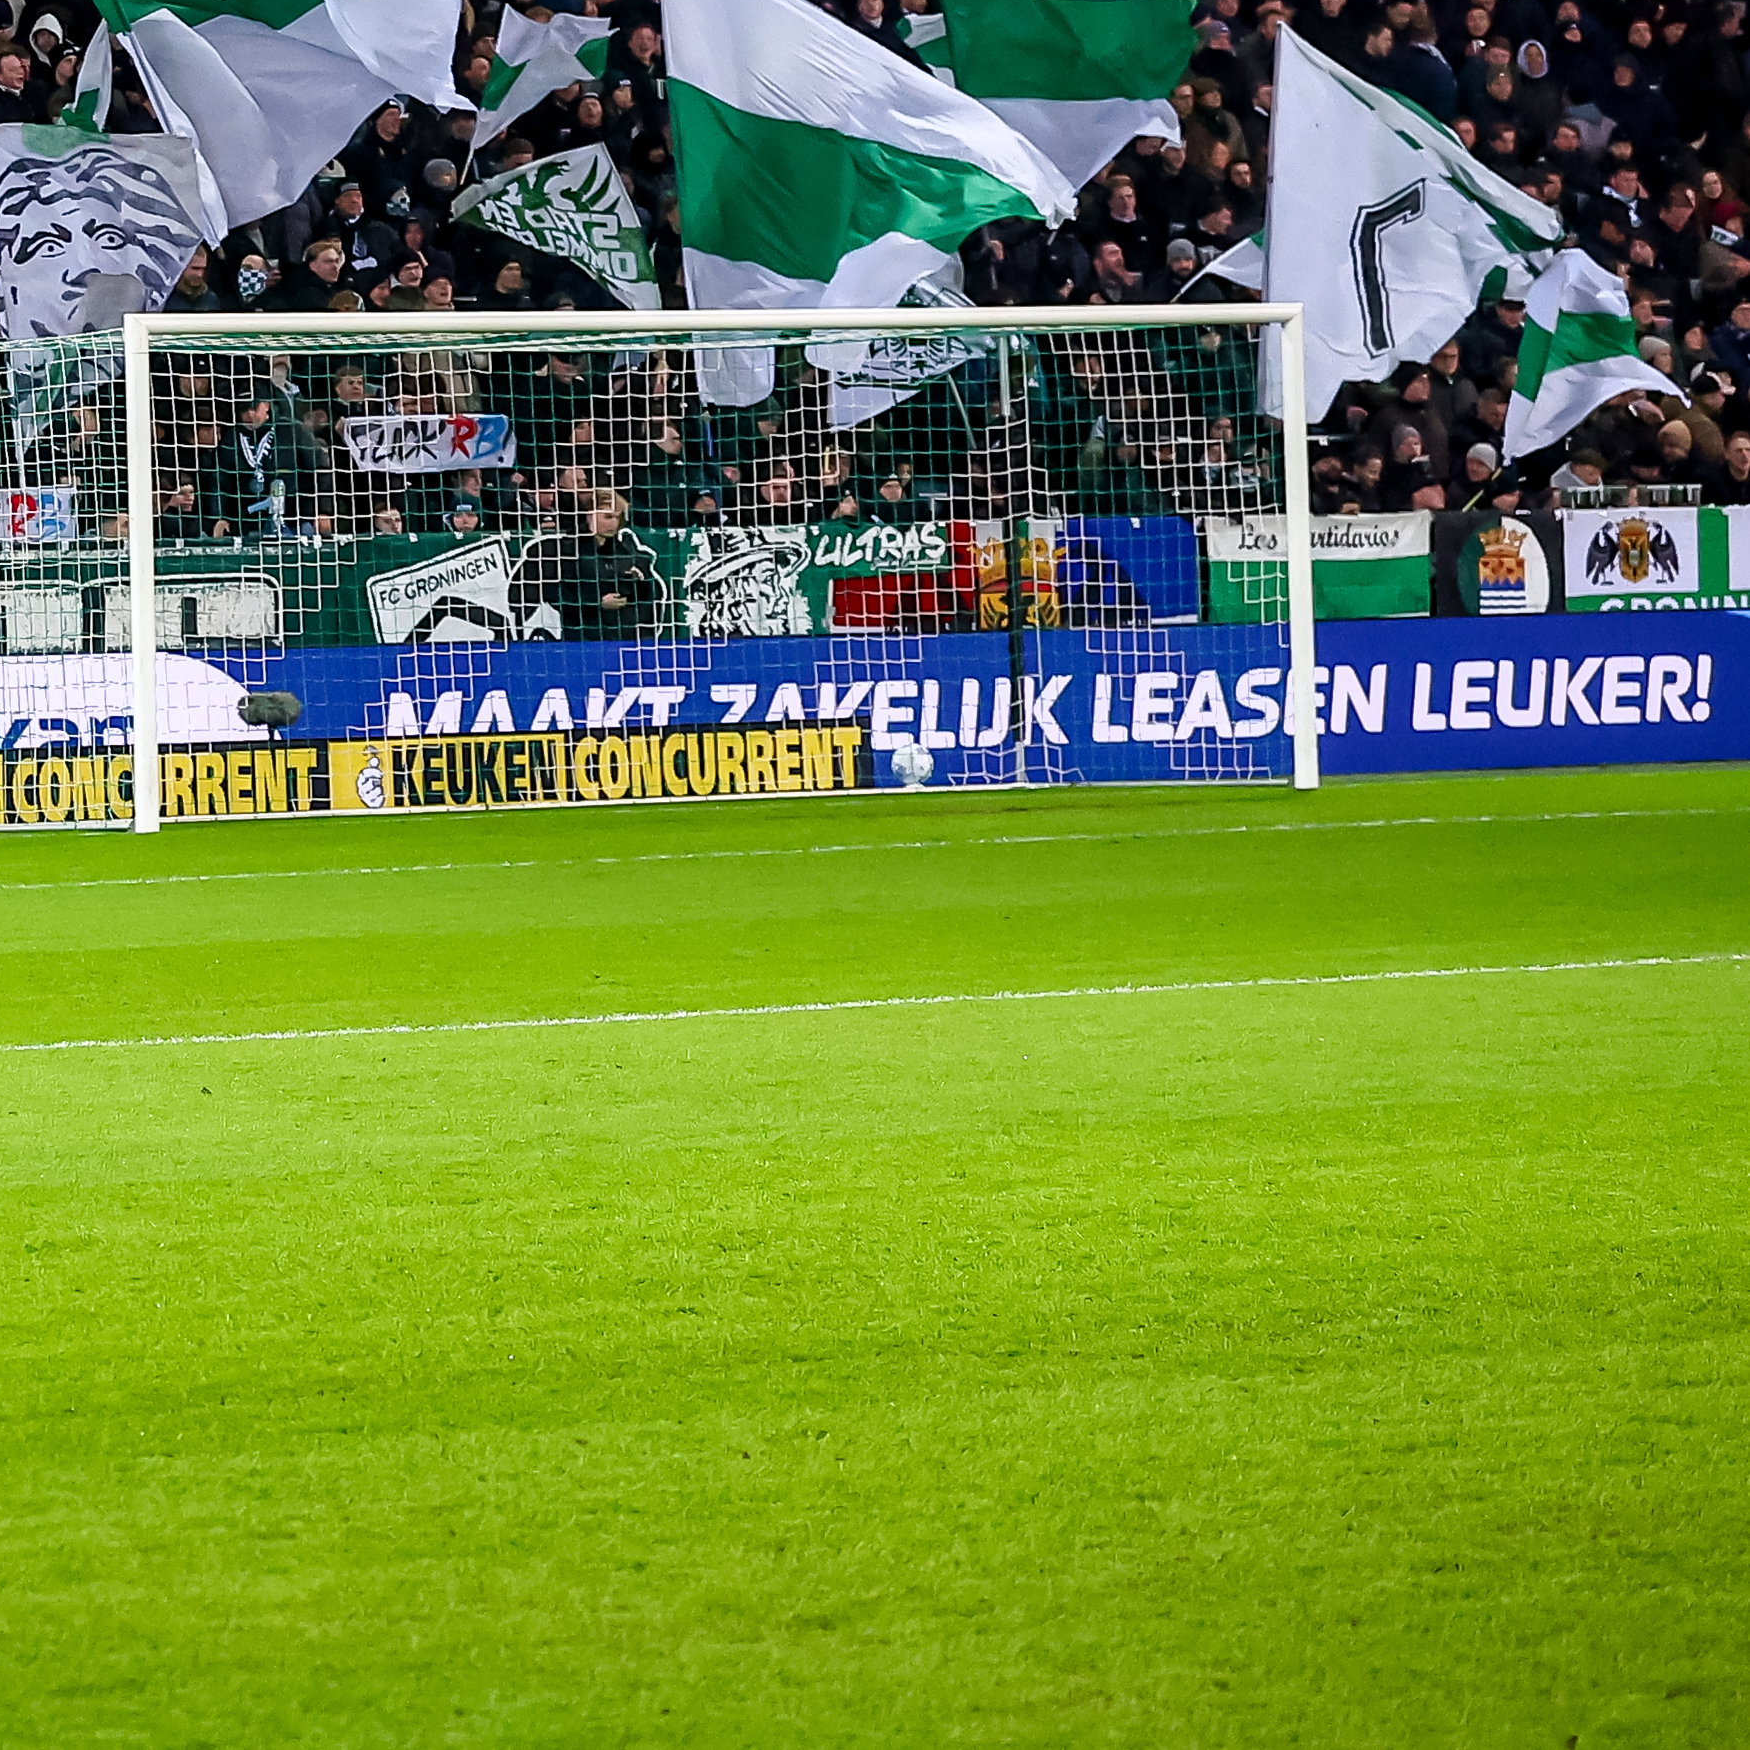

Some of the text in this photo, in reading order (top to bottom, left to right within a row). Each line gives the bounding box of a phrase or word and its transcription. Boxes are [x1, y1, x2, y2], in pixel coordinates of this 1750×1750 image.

[404, 552, 498, 600] GRONINGEN
[1411, 653, 1713, 733] LEUKER!
[13, 747, 318, 826] CONCRRENT
